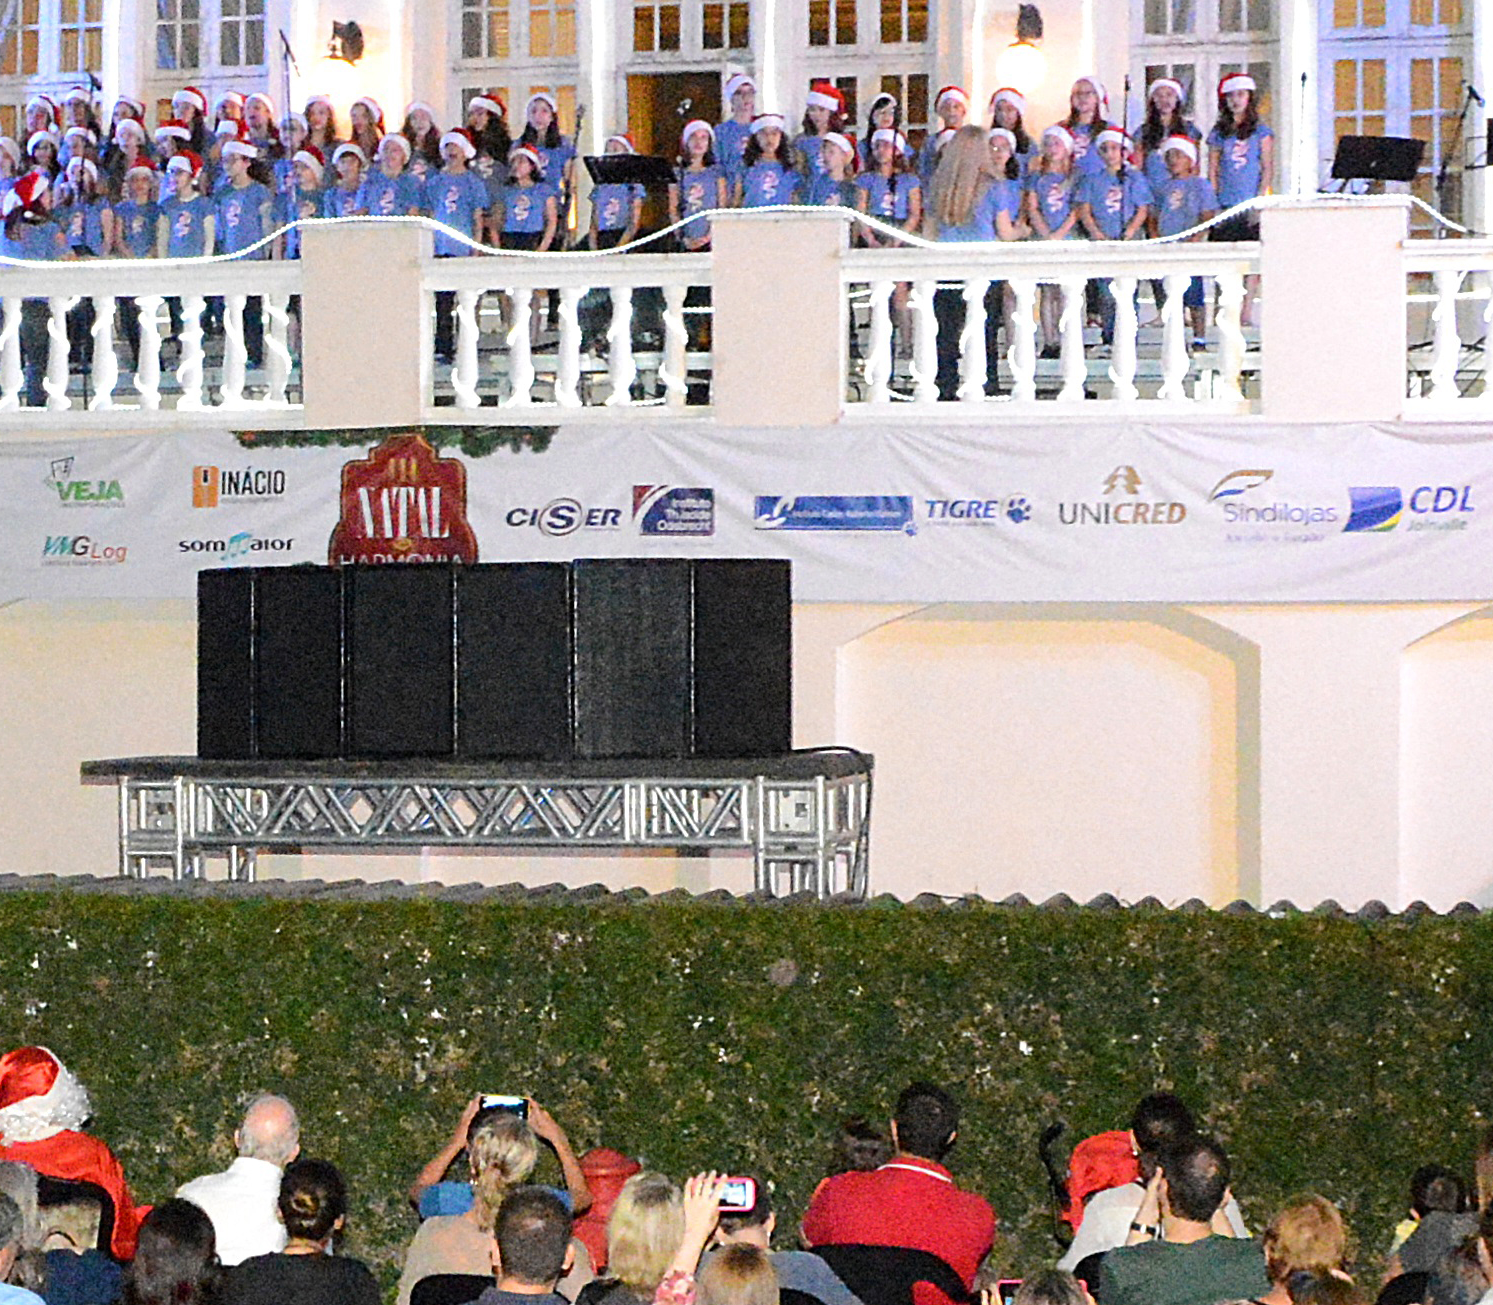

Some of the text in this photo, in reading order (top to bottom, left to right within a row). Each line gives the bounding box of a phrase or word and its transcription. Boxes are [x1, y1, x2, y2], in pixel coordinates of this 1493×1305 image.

[56, 480, 124, 501] VEJA
[221, 465, 286, 495] INÁCIO
[926, 499, 999, 519] TIGRE
[1410, 485, 1475, 514] CDL
[505, 497, 623, 537] CISER
[1058, 501, 1188, 525] UNICRED
[1223, 502, 1338, 526] Sindilojas
